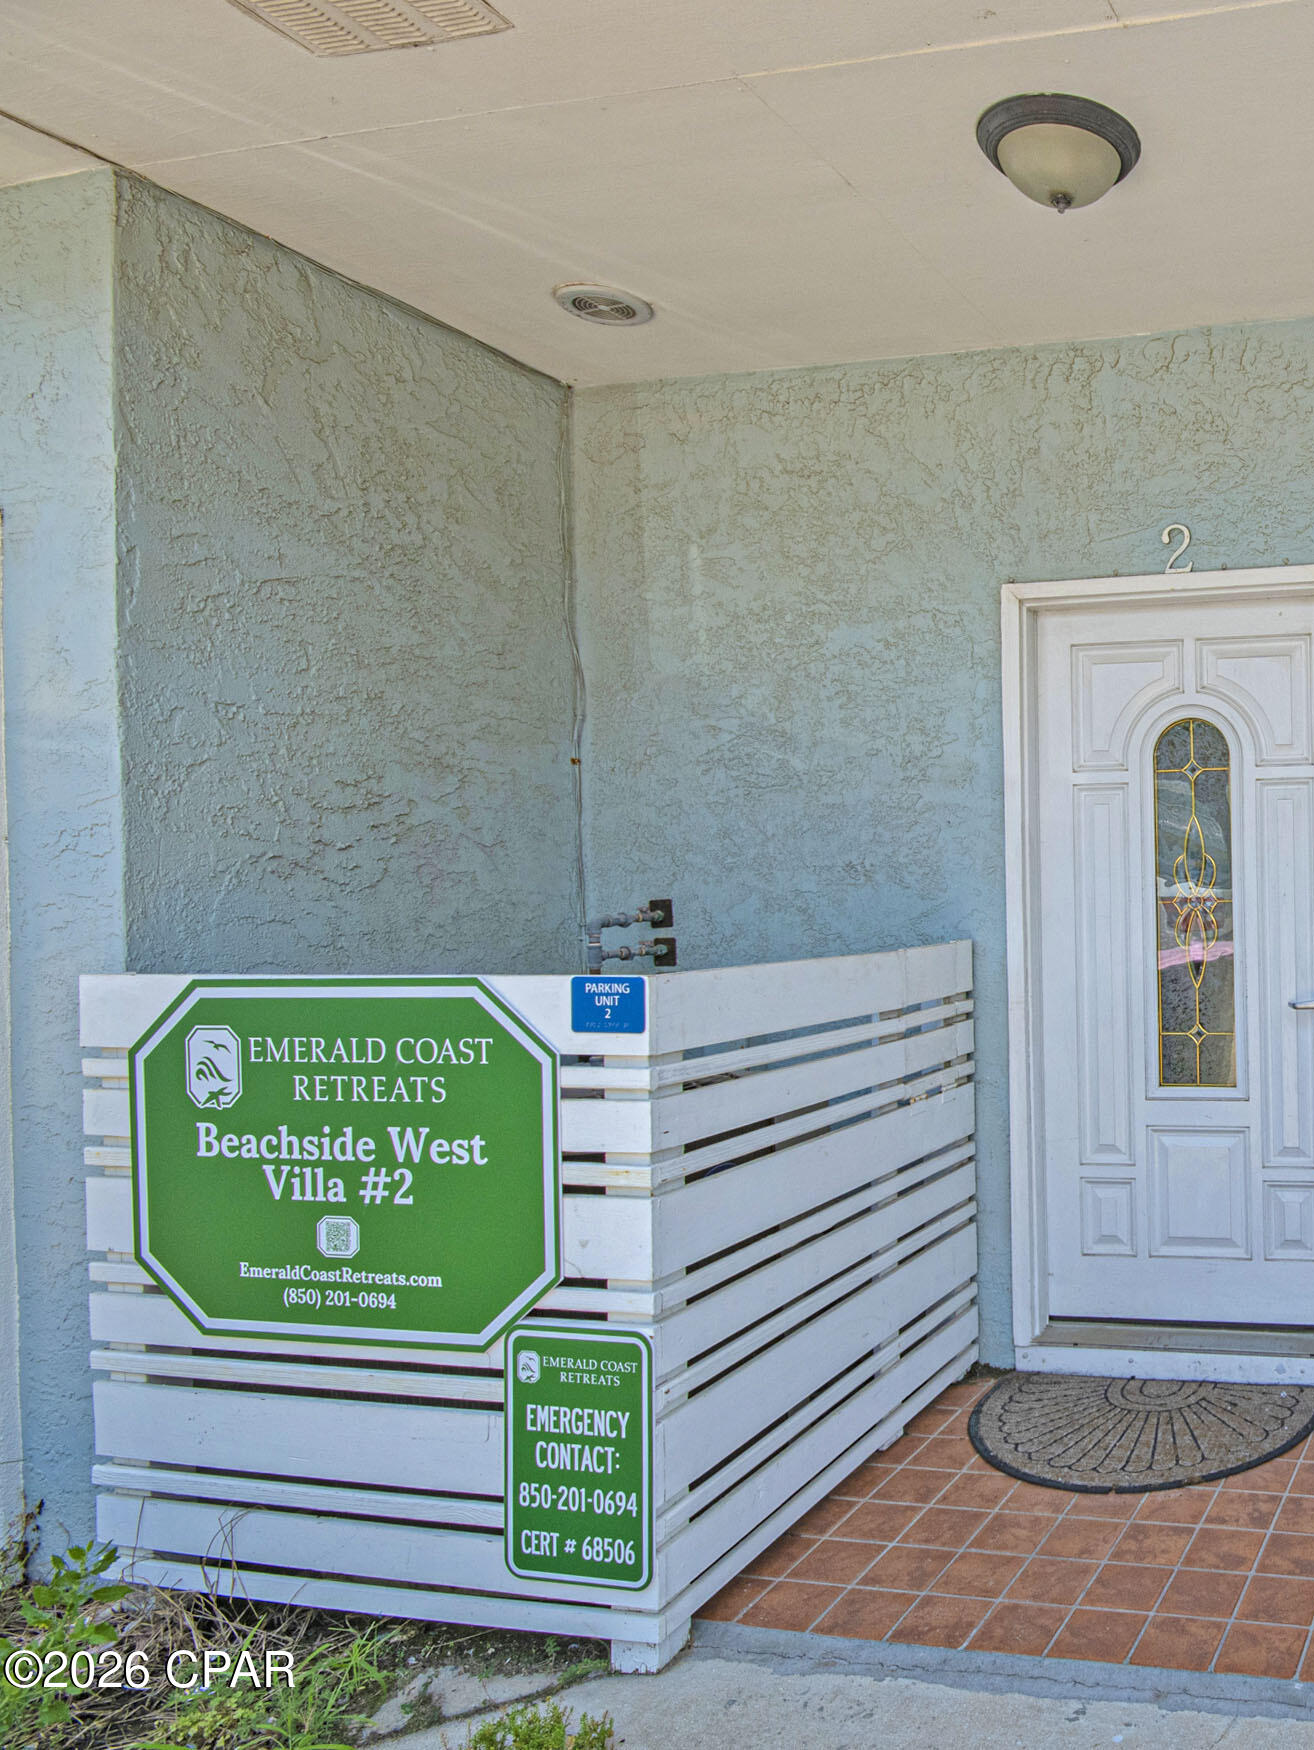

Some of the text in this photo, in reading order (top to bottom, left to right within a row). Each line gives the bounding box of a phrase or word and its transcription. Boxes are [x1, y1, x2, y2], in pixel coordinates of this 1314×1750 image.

[1161, 523, 1193, 574] 2
[585, 983, 630, 994] PARKING
[595, 996, 620, 1006] UNIT
[604, 1008, 611, 1019] 2
[249, 1037, 493, 1065] EMERALD COAST
[293, 1075, 447, 1103] RETREATS
[196, 1122, 488, 1165] Beachside West
[262, 1165, 414, 1205] Villa #2
[239, 1262, 443, 1287] EmeraldCoastRetreats.com
[283, 1288, 396, 1309] (850) 201-0694
[543, 1356, 638, 1374] EMERALD COAST
[560, 1371, 621, 1386] RETREATS
[526, 1404, 630, 1439] EMERGENCY
[535, 1441, 620, 1474] CONTACT:
[519, 1482, 637, 1517] 850-201-0694
[521, 1530, 635, 1565] CERT # 68506
